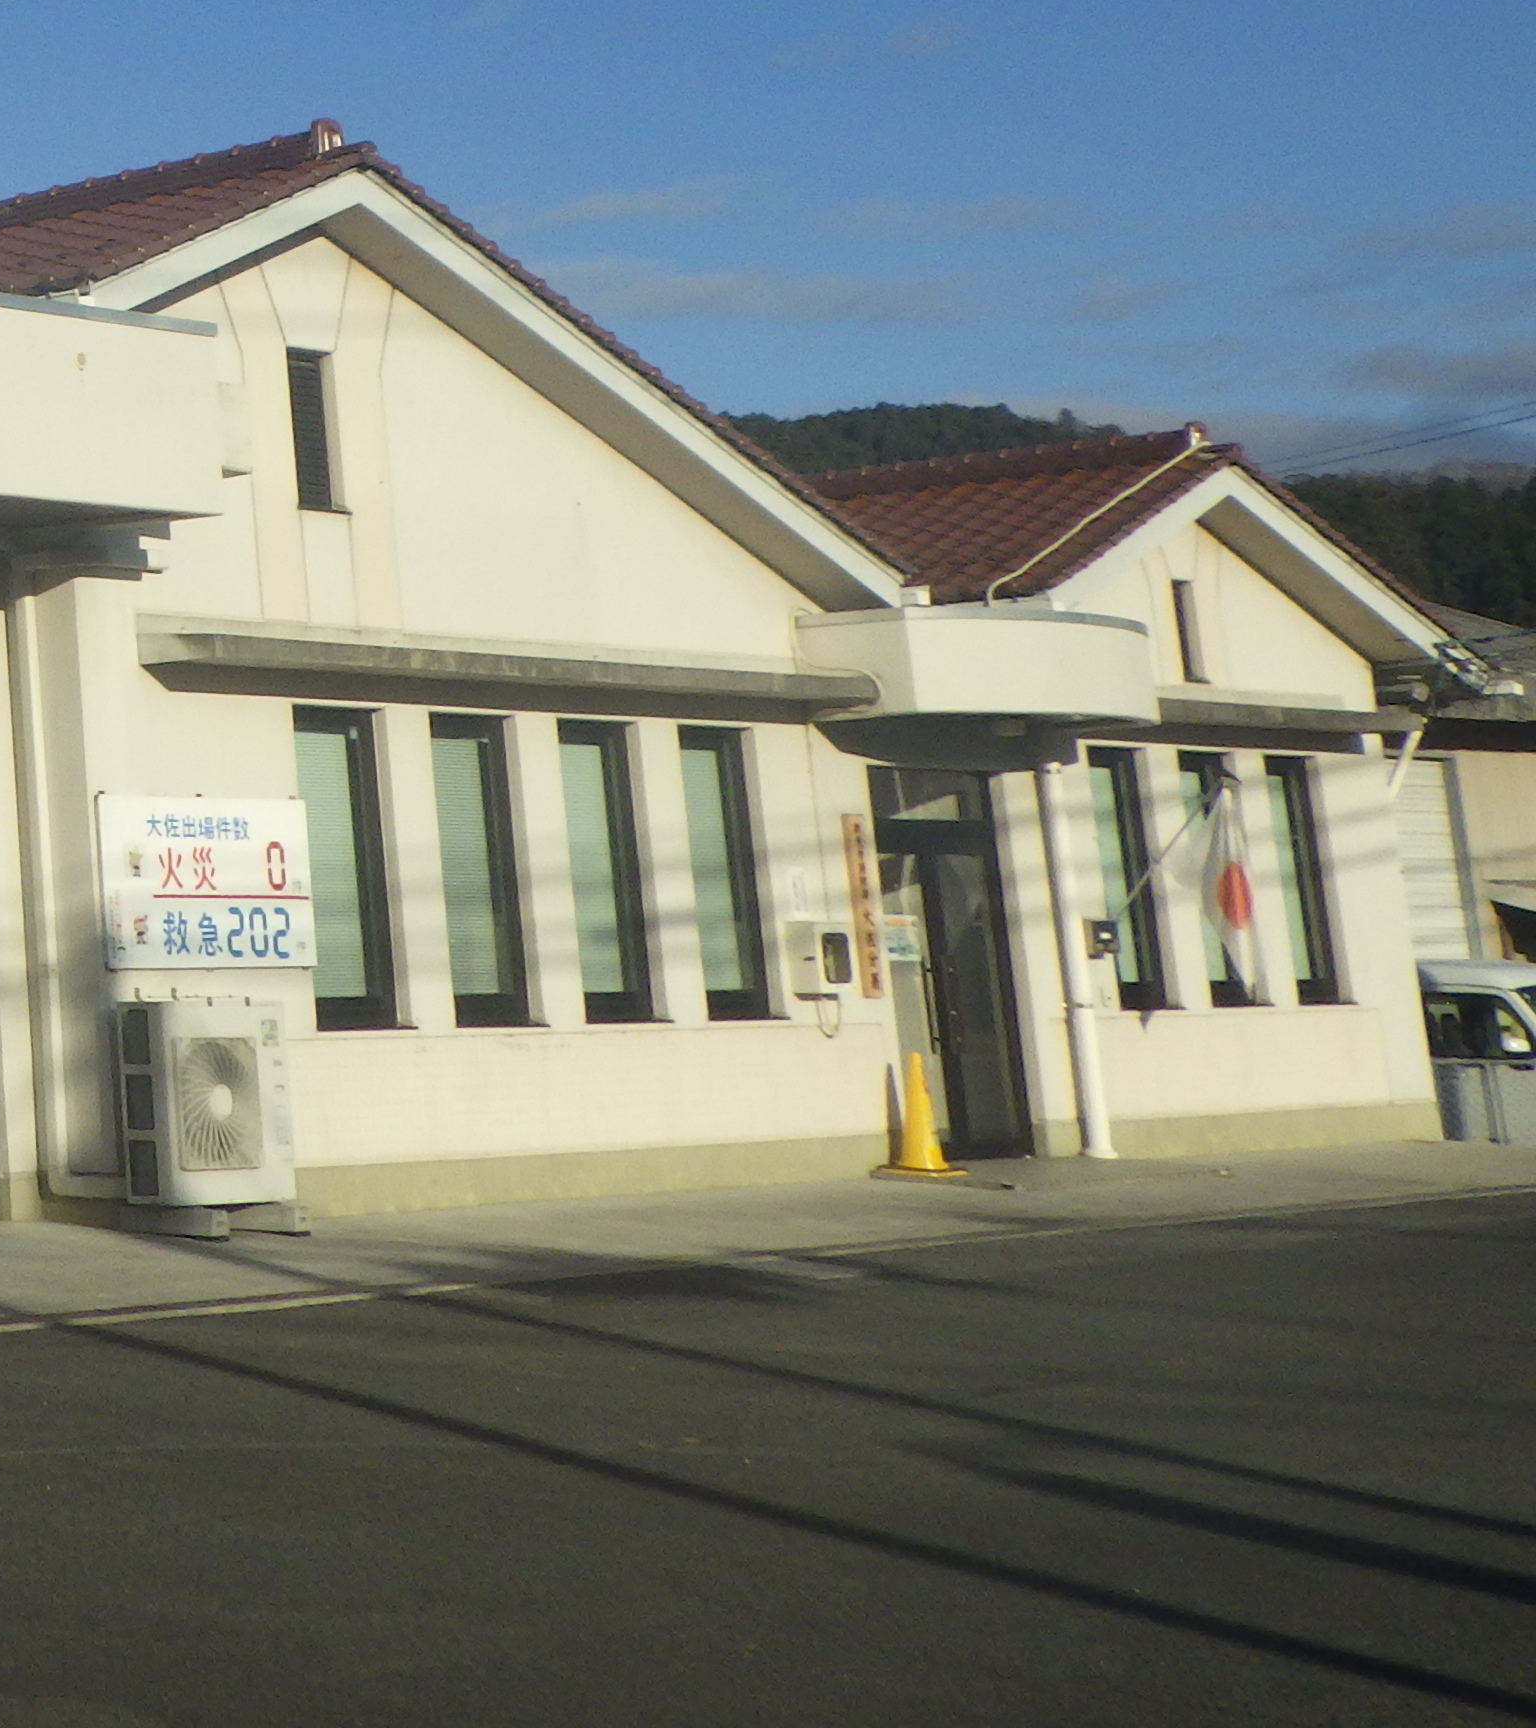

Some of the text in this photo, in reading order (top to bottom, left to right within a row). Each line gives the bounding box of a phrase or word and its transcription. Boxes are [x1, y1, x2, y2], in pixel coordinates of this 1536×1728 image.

[146, 814, 250, 841] 大佐出場件数
[158, 847, 217, 891] 火災
[266, 841, 287, 891] 0
[162, 910, 224, 957] 救急
[227, 906, 291, 960] 202
